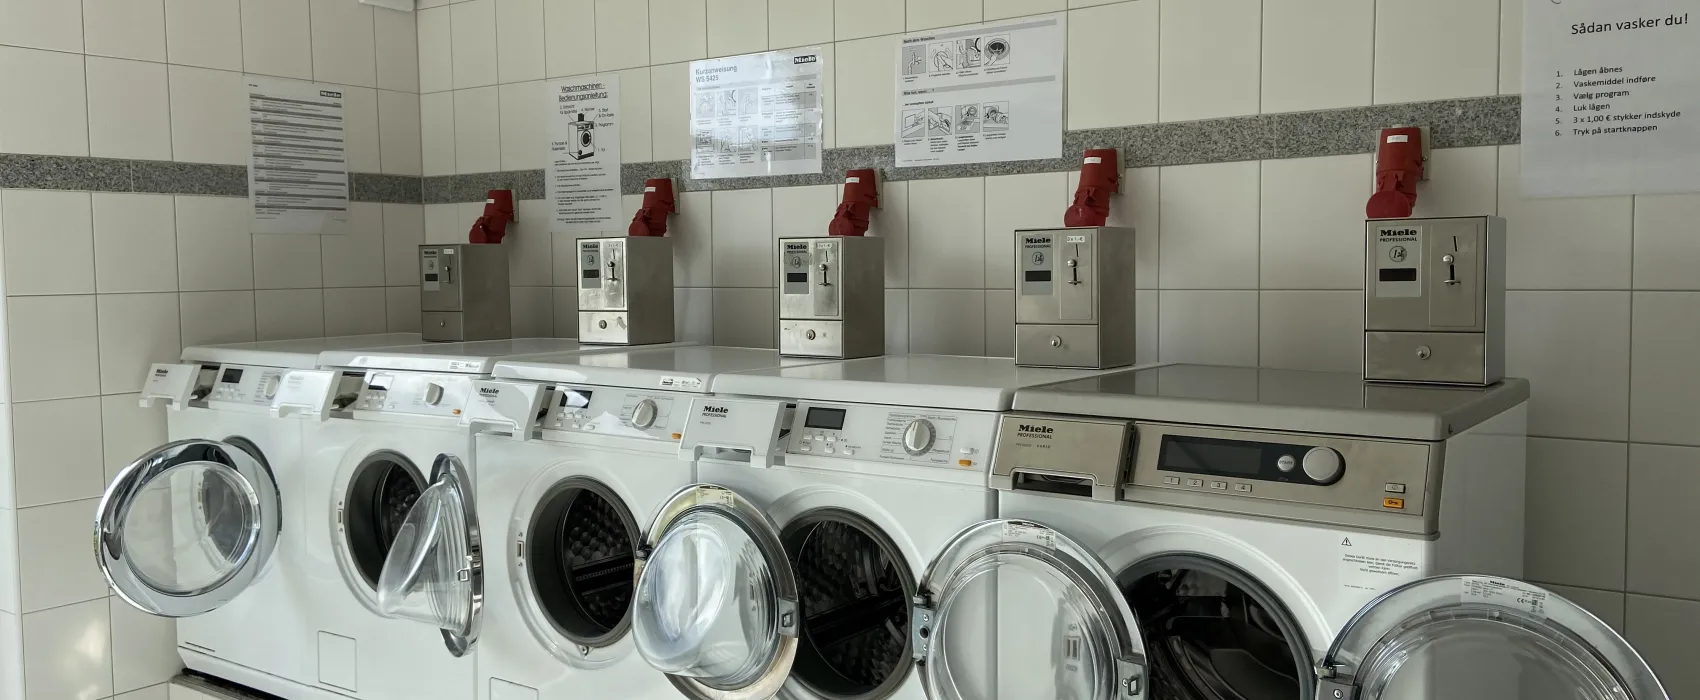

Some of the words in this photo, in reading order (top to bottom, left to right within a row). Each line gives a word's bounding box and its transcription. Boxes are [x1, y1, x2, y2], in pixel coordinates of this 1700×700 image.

[1571, 22, 1612, 35] Sådan
[1616, 17, 1661, 30] vasker
[1664, 13, 1688, 27] du!
[794, 56, 816, 64] Miele
[696, 65, 738, 75] Kurzanweisung
[1574, 68, 1597, 77] Lågen
[1599, 66, 1623, 74] åbnes
[1574, 77, 1624, 88] Vaskemiddel
[1626, 75, 1656, 84] indføre
[1573, 92, 1594, 101] Vælg
[1595, 90, 1630, 100] program
[1588, 102, 1611, 112] lågen
[1587, 115, 1604, 124] 1,00
[1605, 114, 1612, 122] €
[1612, 113, 1642, 123] stykker
[1644, 110, 1681, 121] indskyde
[1573, 128, 1590, 137] Tryk
[1591, 126, 1602, 136] på
[1603, 124, 1658, 135] startknappen
[1018, 425, 1054, 434] Miele
